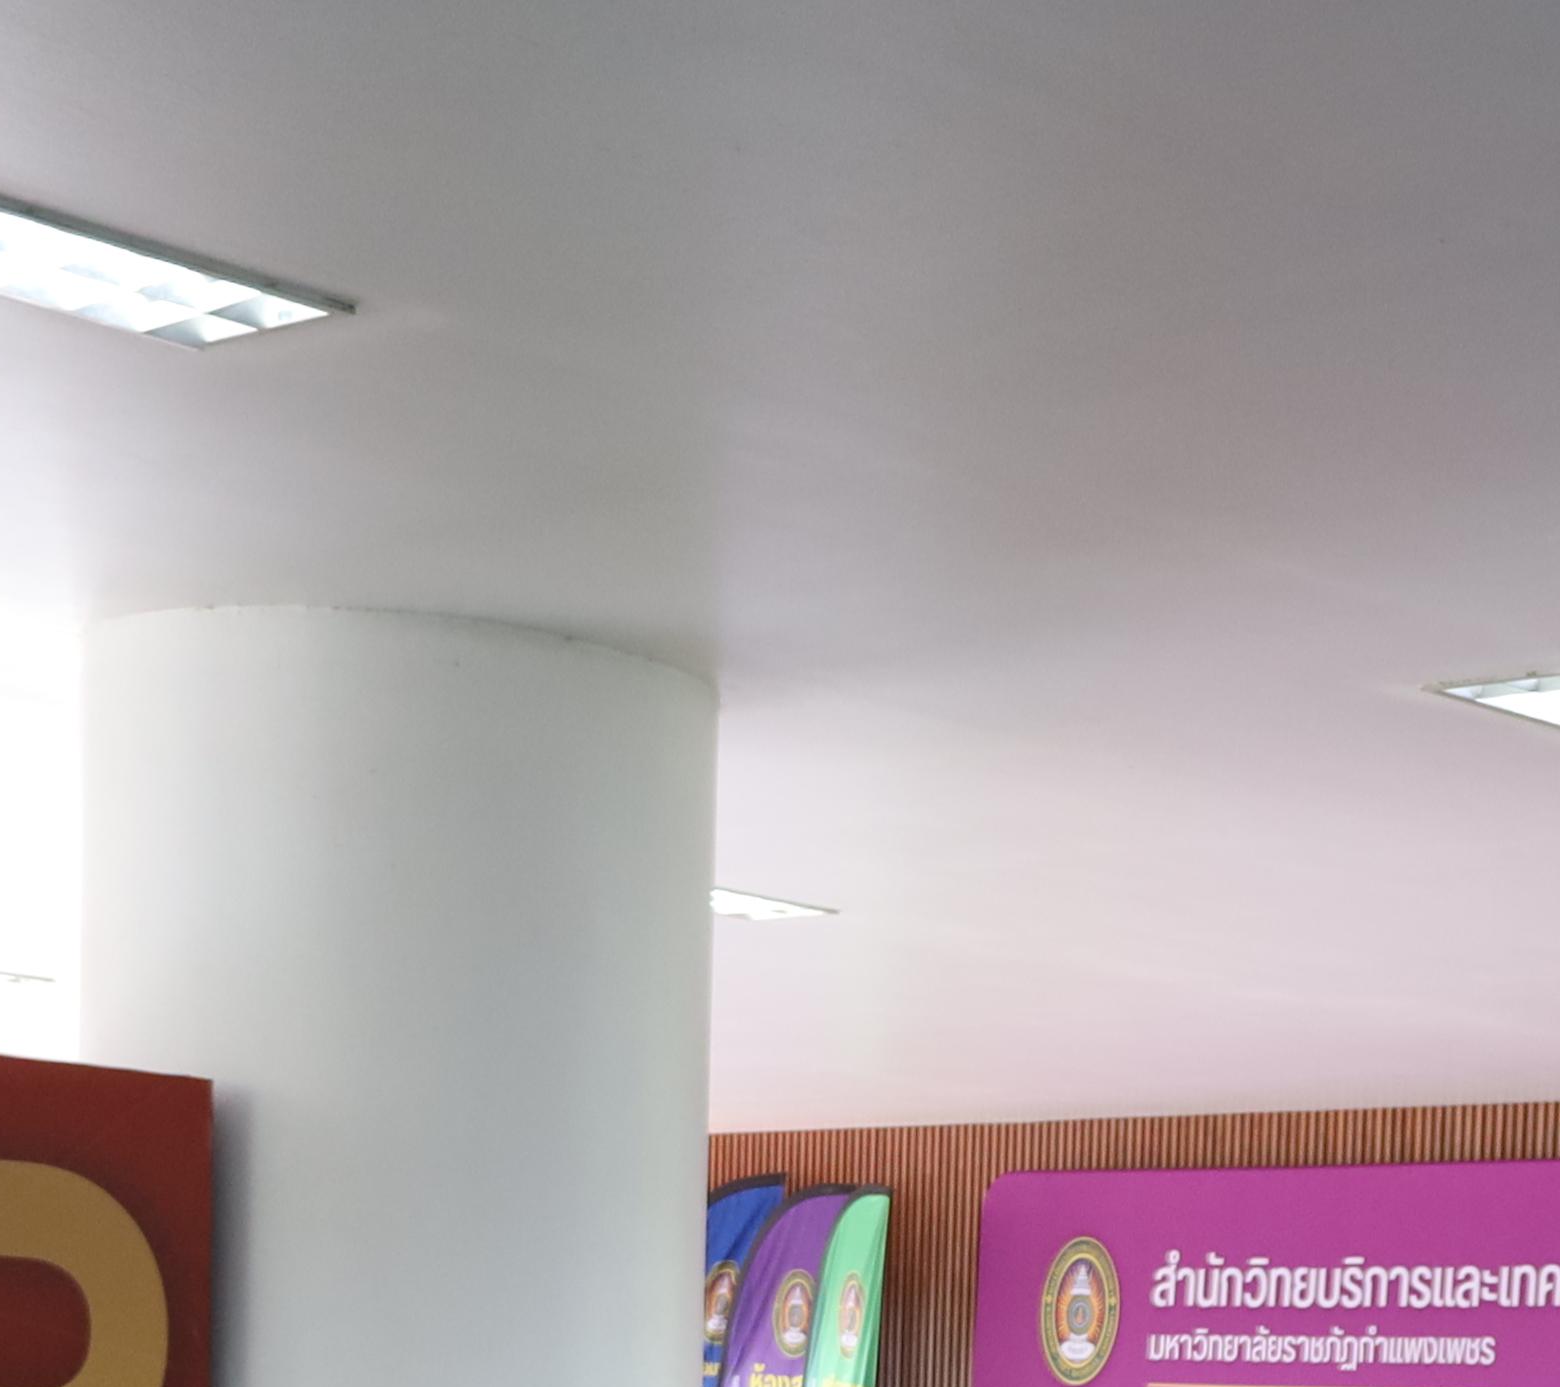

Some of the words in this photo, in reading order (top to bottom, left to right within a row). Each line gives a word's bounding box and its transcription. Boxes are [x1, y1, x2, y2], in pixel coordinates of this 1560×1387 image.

[1146, 1324, 1496, 1372] มหาวิทยาลัยราชภัฏกำแพงเพชร
